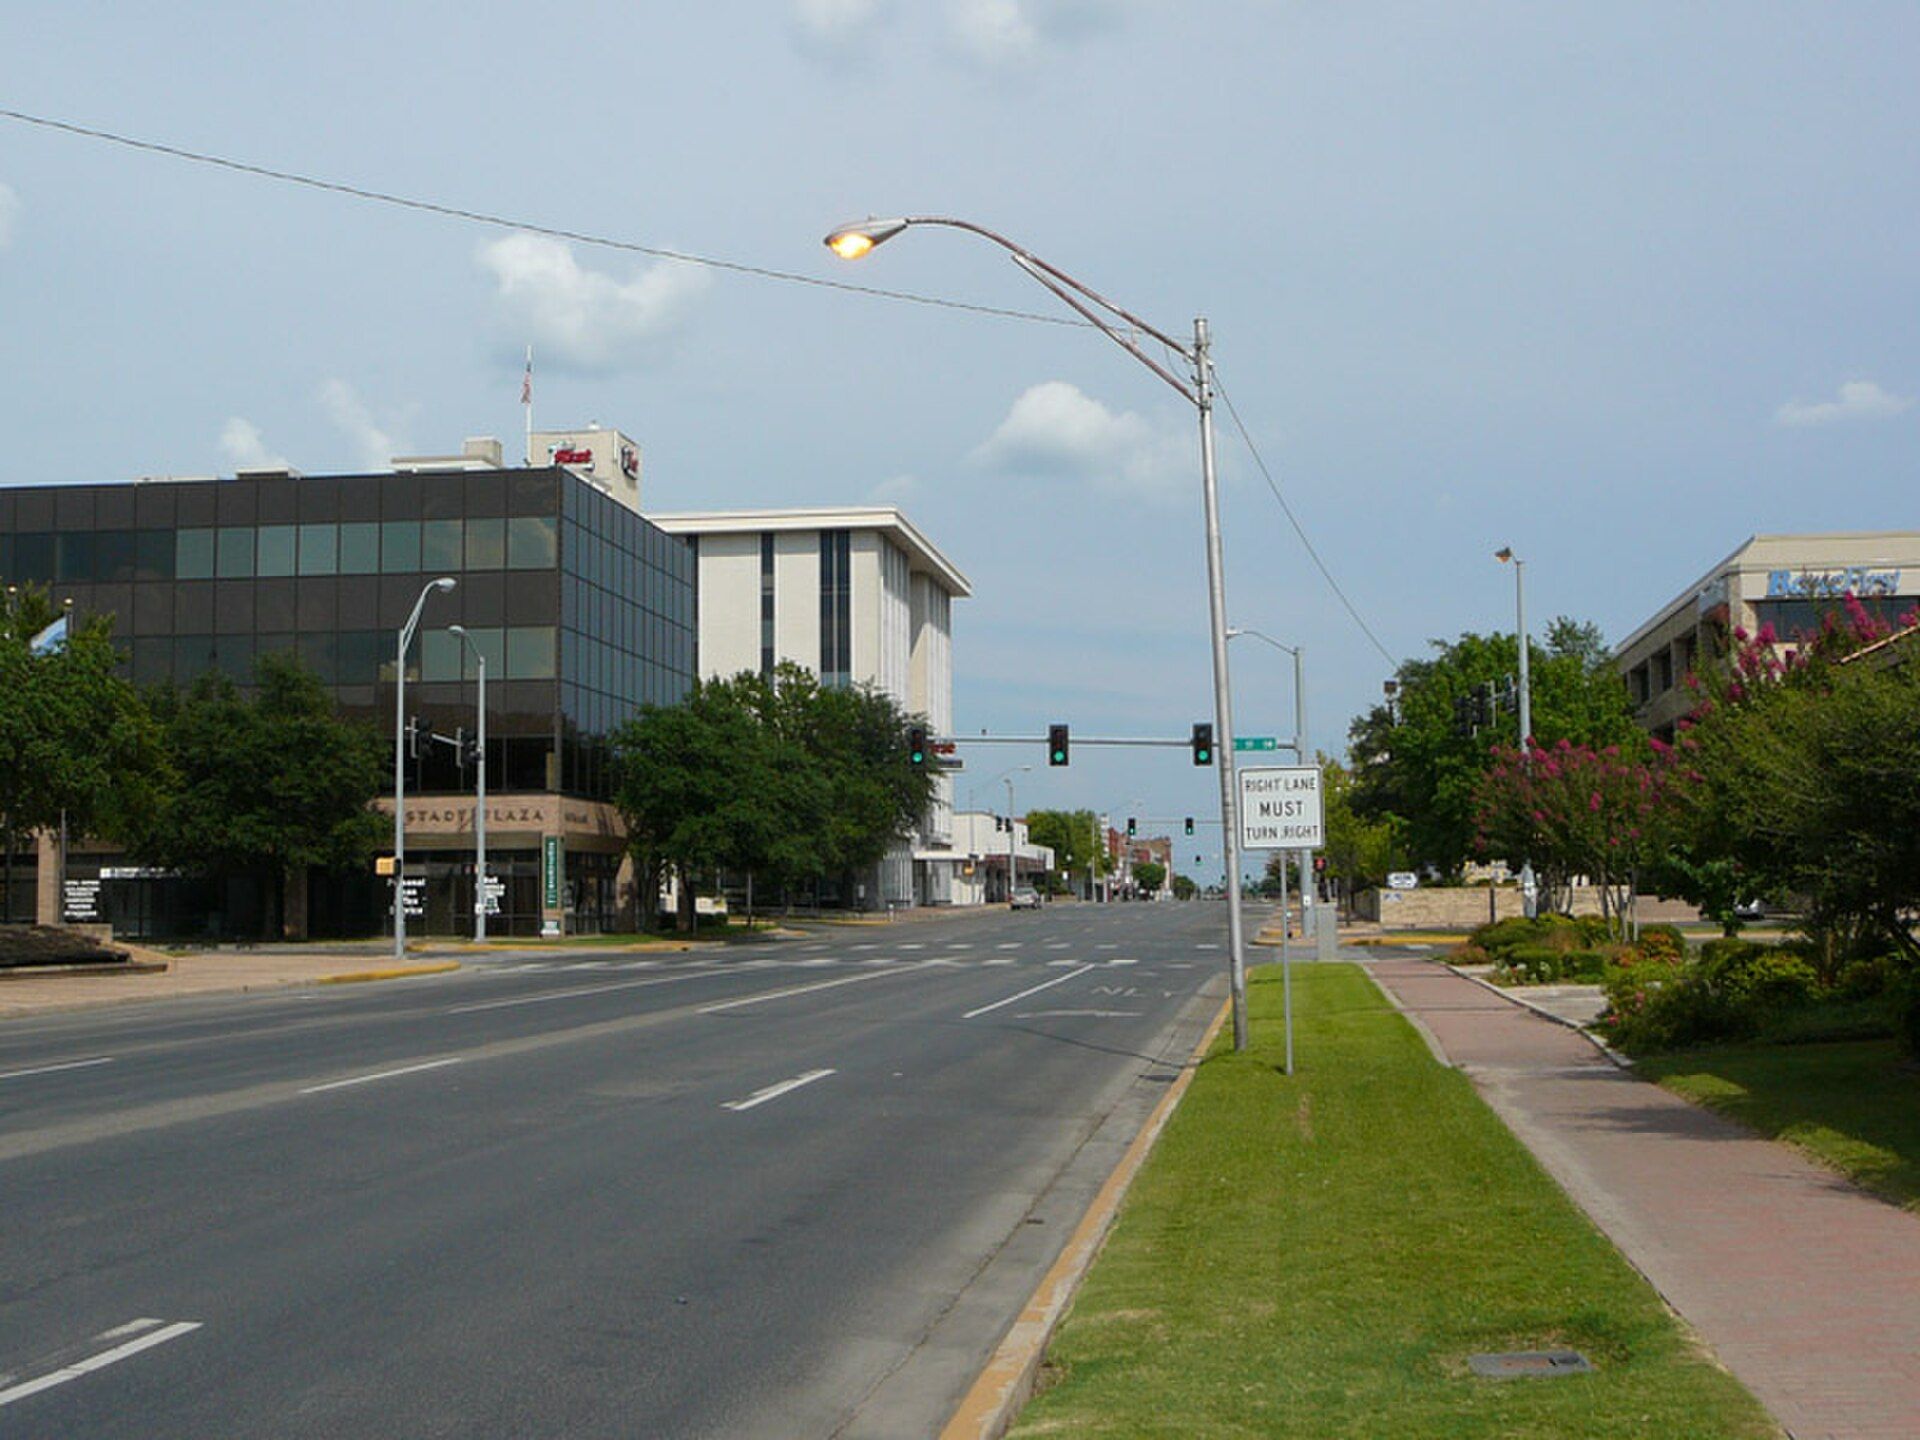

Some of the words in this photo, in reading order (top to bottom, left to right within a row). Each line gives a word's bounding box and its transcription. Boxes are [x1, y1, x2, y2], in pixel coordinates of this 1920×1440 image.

[1245, 778, 1282, 792] RIGHT
[1285, 777, 1317, 790] LANE
[1259, 801, 1303, 817] MUST
[1246, 826, 1278, 839] TURN
[1283, 825, 1318, 838] RIGHT
